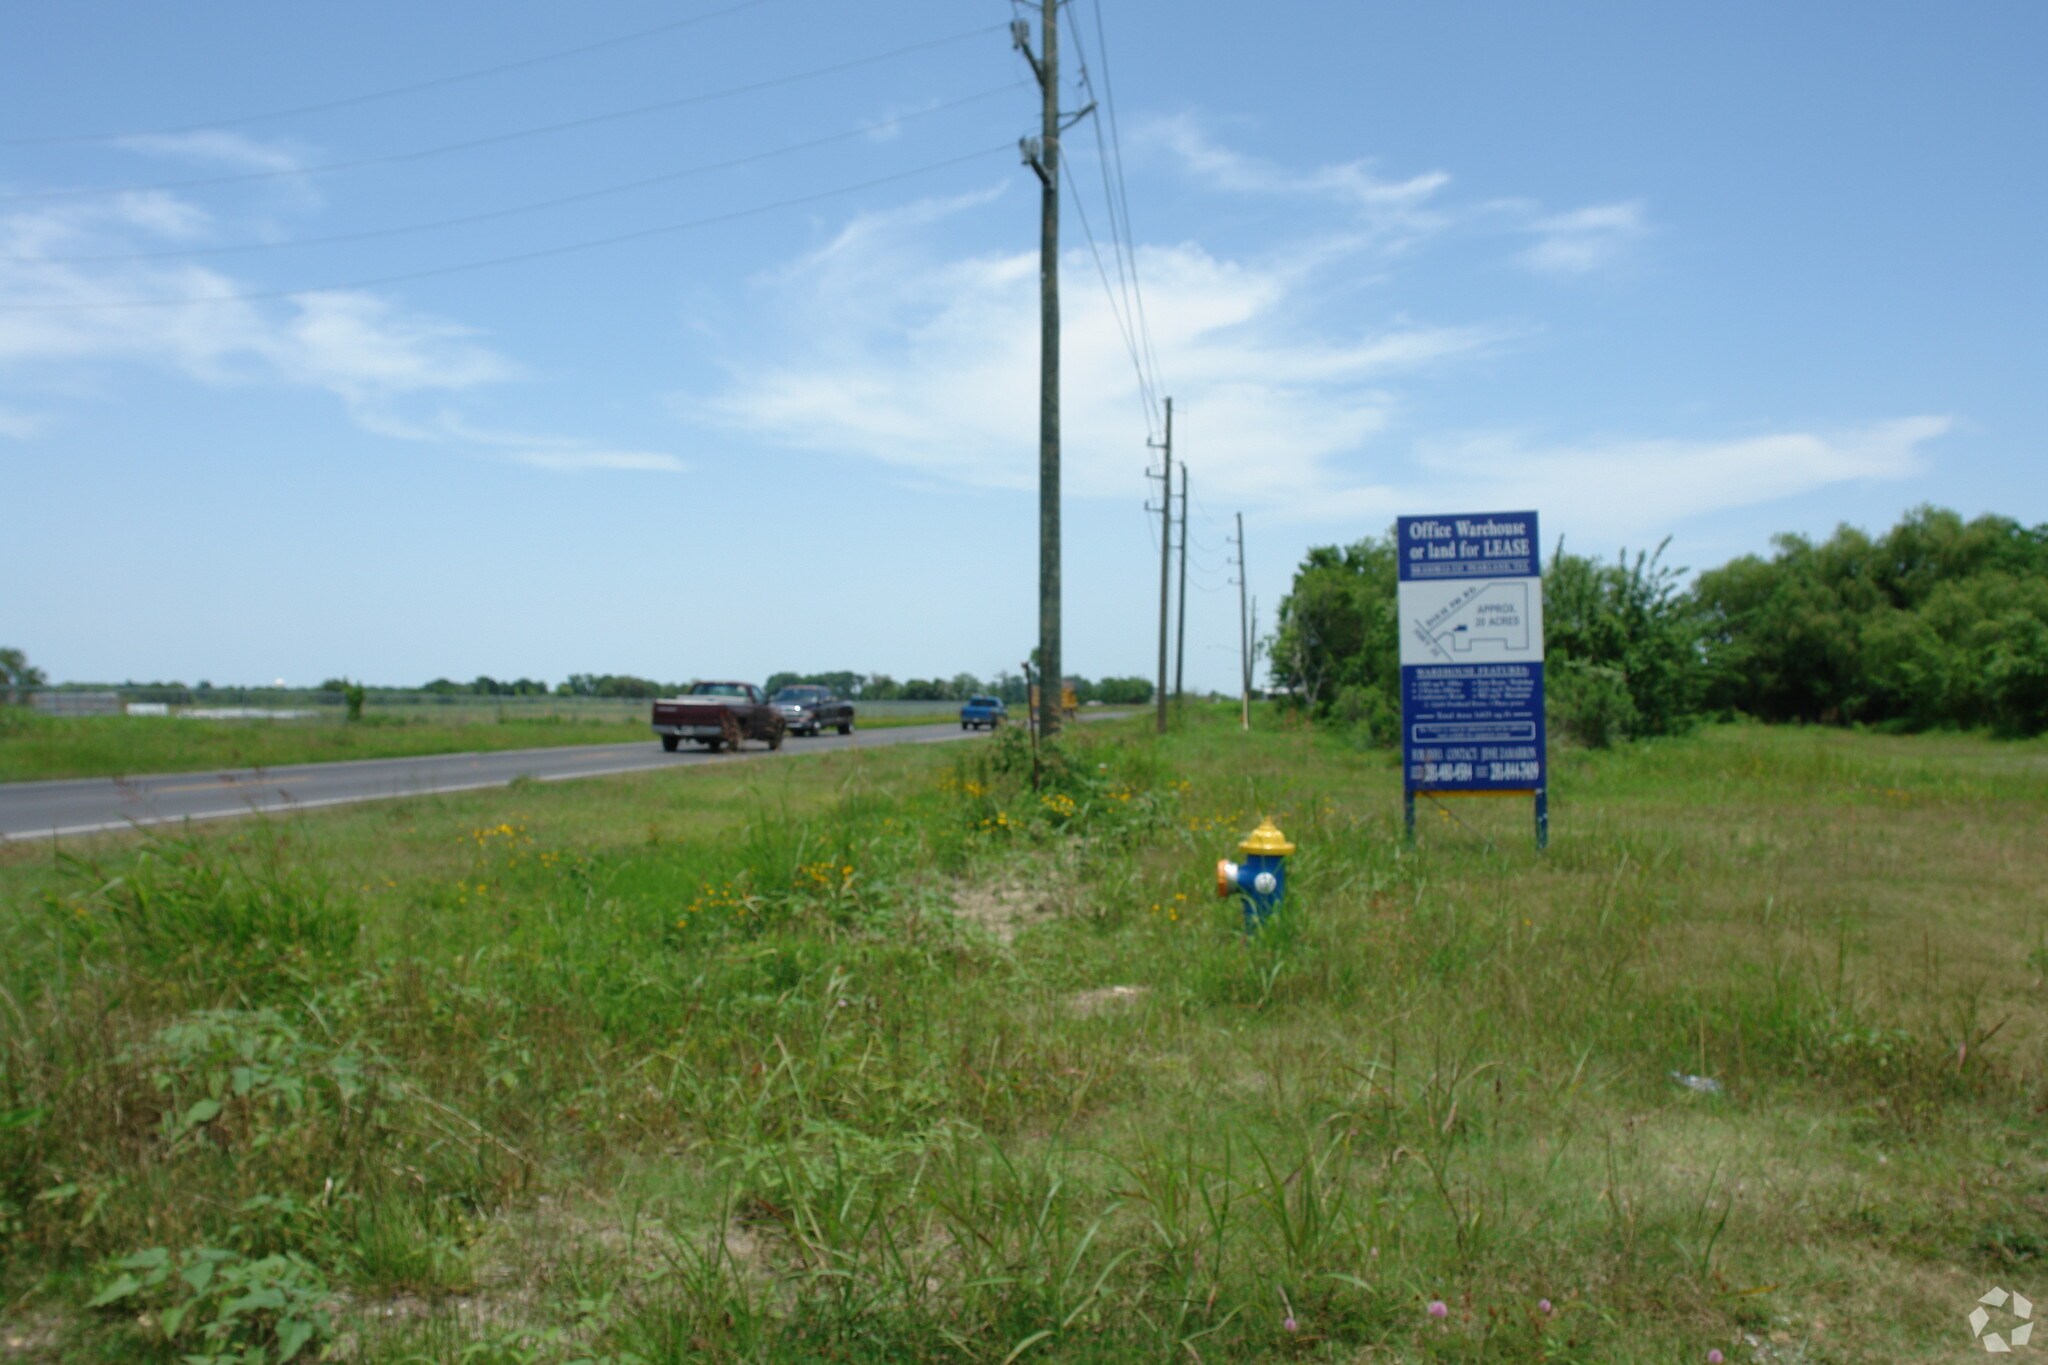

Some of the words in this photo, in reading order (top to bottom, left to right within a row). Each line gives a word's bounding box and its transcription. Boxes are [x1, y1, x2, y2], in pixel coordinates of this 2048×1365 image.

[1409, 521, 1452, 540] Office
[1456, 518, 1526, 538] Warehouse
[1409, 546, 1425, 560] or
[1428, 541, 1456, 559] land
[1459, 540, 1480, 558] for
[1483, 538, 1530, 557] LEASE
